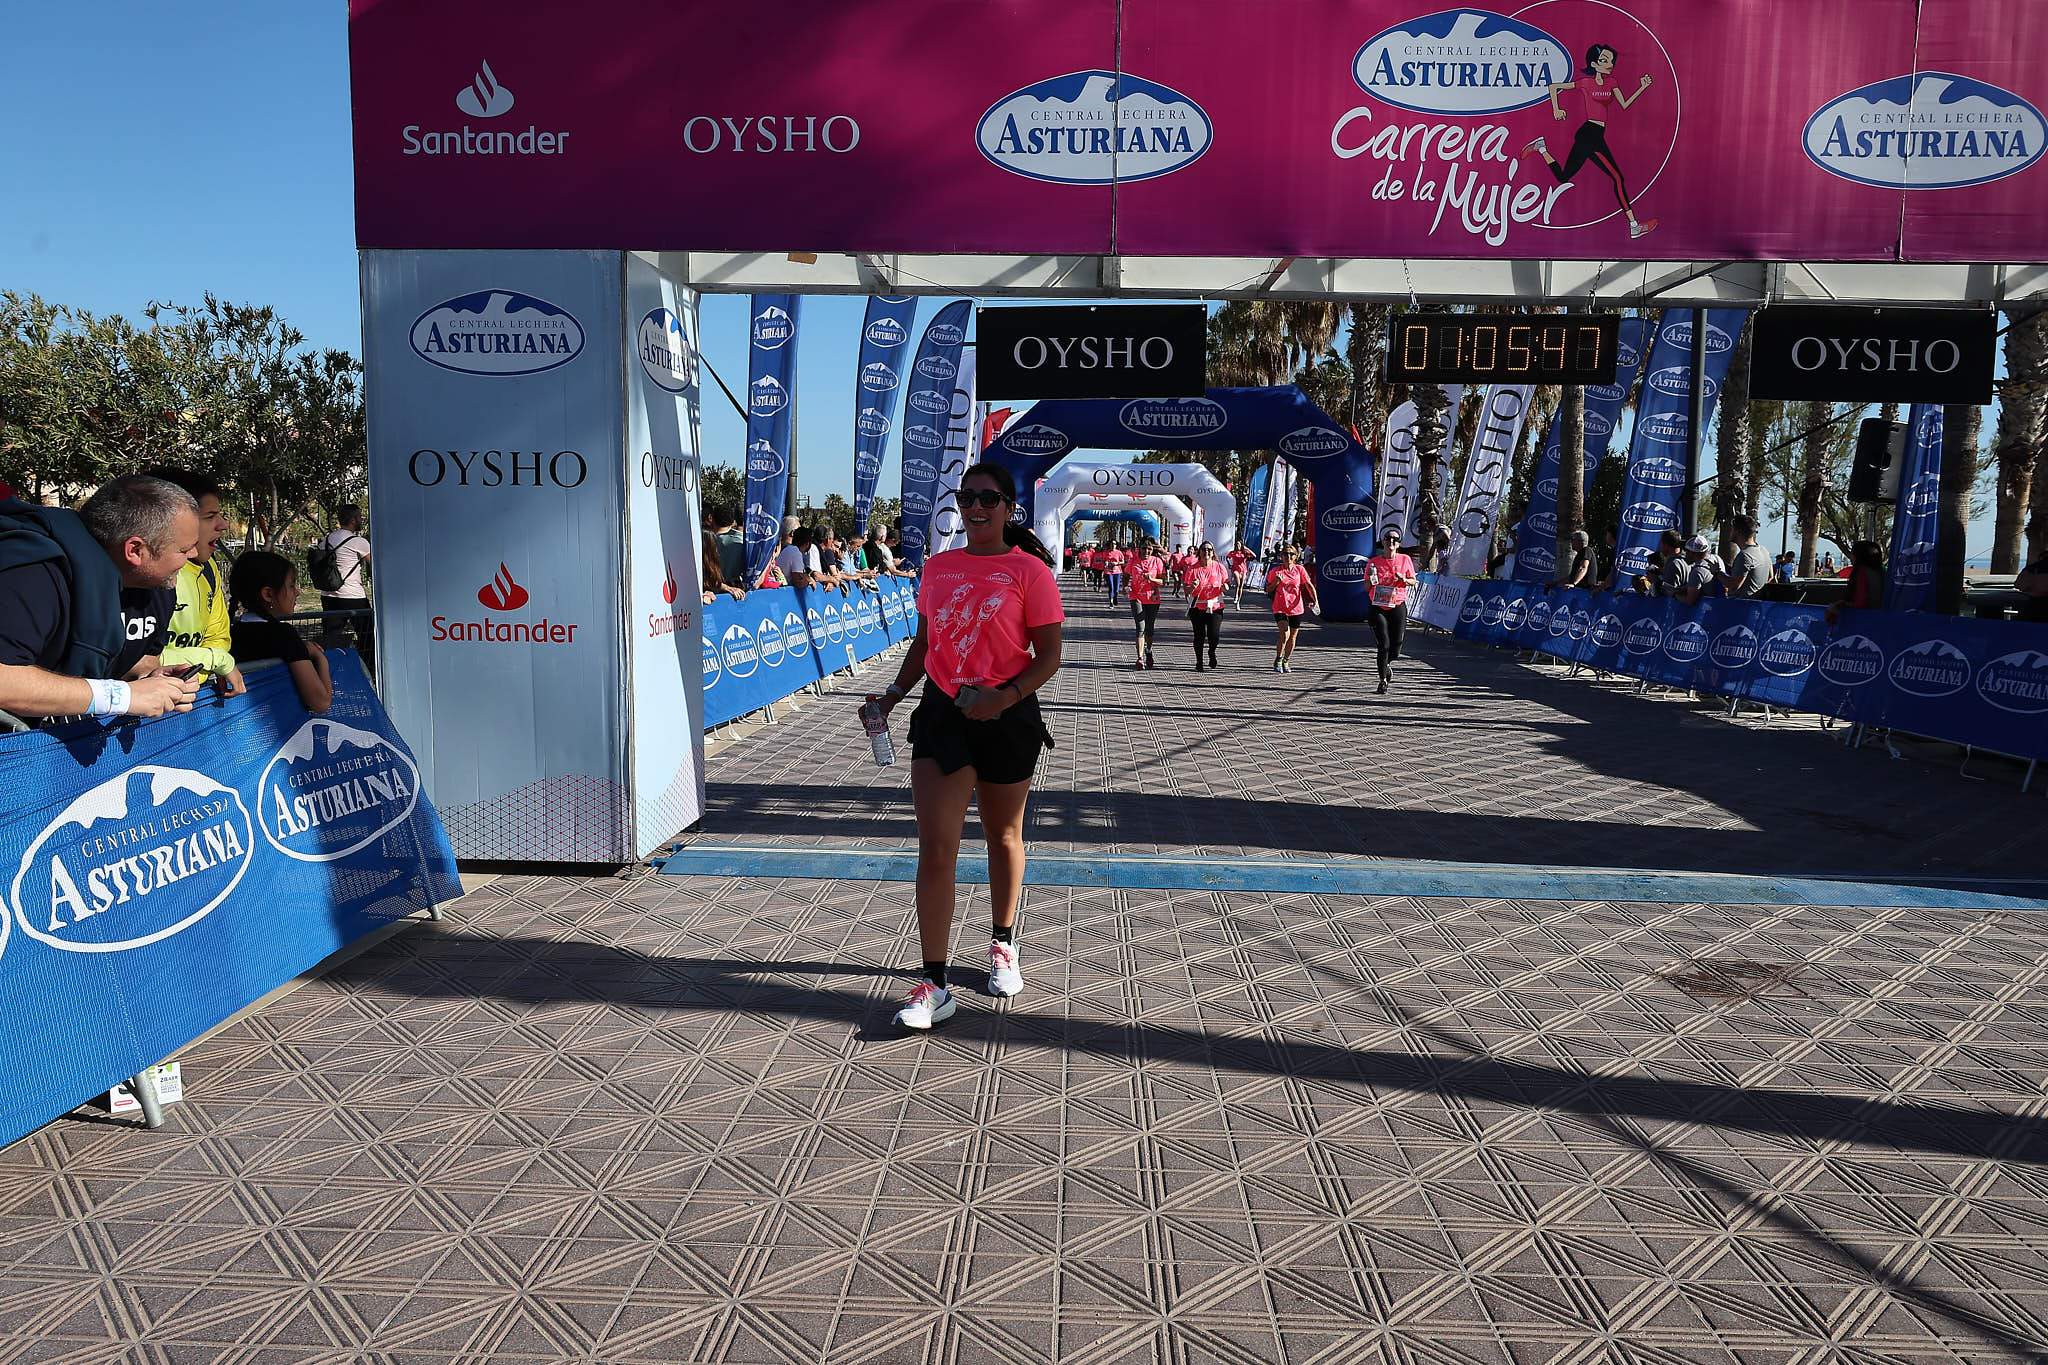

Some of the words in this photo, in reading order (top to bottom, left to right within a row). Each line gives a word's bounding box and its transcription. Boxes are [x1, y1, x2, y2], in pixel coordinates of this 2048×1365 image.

[1369, 47, 1552, 88] ASTURIANA
[1404, 45, 1472, 56] CENTRAL
[1480, 45, 1549, 56] LECHERA
[1031, 110, 1104, 121] CENTRAL
[1860, 112, 1936, 124] CENTRAL
[1945, 112, 2025, 123] LECHERA
[402, 125, 570, 155] Santander
[683, 115, 861, 153] OYSHO
[994, 113, 1194, 154] ASTURIANA
[1331, 106, 1511, 163] Carrera
[1820, 115, 2029, 158] ASTURIANA
[1372, 164, 1404, 201] de
[1413, 163, 1436, 201] la
[1428, 158, 1575, 247] Mujer
[423, 321, 572, 354] ASTURIANA
[449, 319, 505, 329] CENTRAL
[509, 319, 566, 329] LECHERA
[643, 329, 690, 378] ASTURIANA
[1013, 336, 1174, 370] OYSHO
[1404, 325, 1601, 371] 01:05:47
[1791, 336, 1961, 373] OYSHO
[1127, 406, 1220, 427] ASTURIANA
[1007, 436, 1063, 448] ASTURIANA
[1284, 439, 1345, 451] ASTURIANA
[408, 450, 587, 488] OYSHO
[641, 451, 695, 493] OYSHO
[1093, 469, 1175, 487] OYSHO
[1459, 389, 1523, 538] OYSHO
[1325, 510, 1372, 525] ASTURIANA
[431, 616, 578, 643] Santander
[648, 610, 692, 638] Santander
[1762, 643, 1810, 667] ASTURIANA
[1821, 650, 1877, 675] ASTURIANA
[1892, 656, 1962, 686] ASTURIANA
[289, 763, 335, 789] CENTRAL
[336, 750, 392, 778] LECHERA
[274, 767, 411, 841] ASTURIANA
[81, 822, 159, 859] CENTRAL
[162, 798, 230, 834] LECHERA
[47, 819, 246, 932] ASTURIANA
